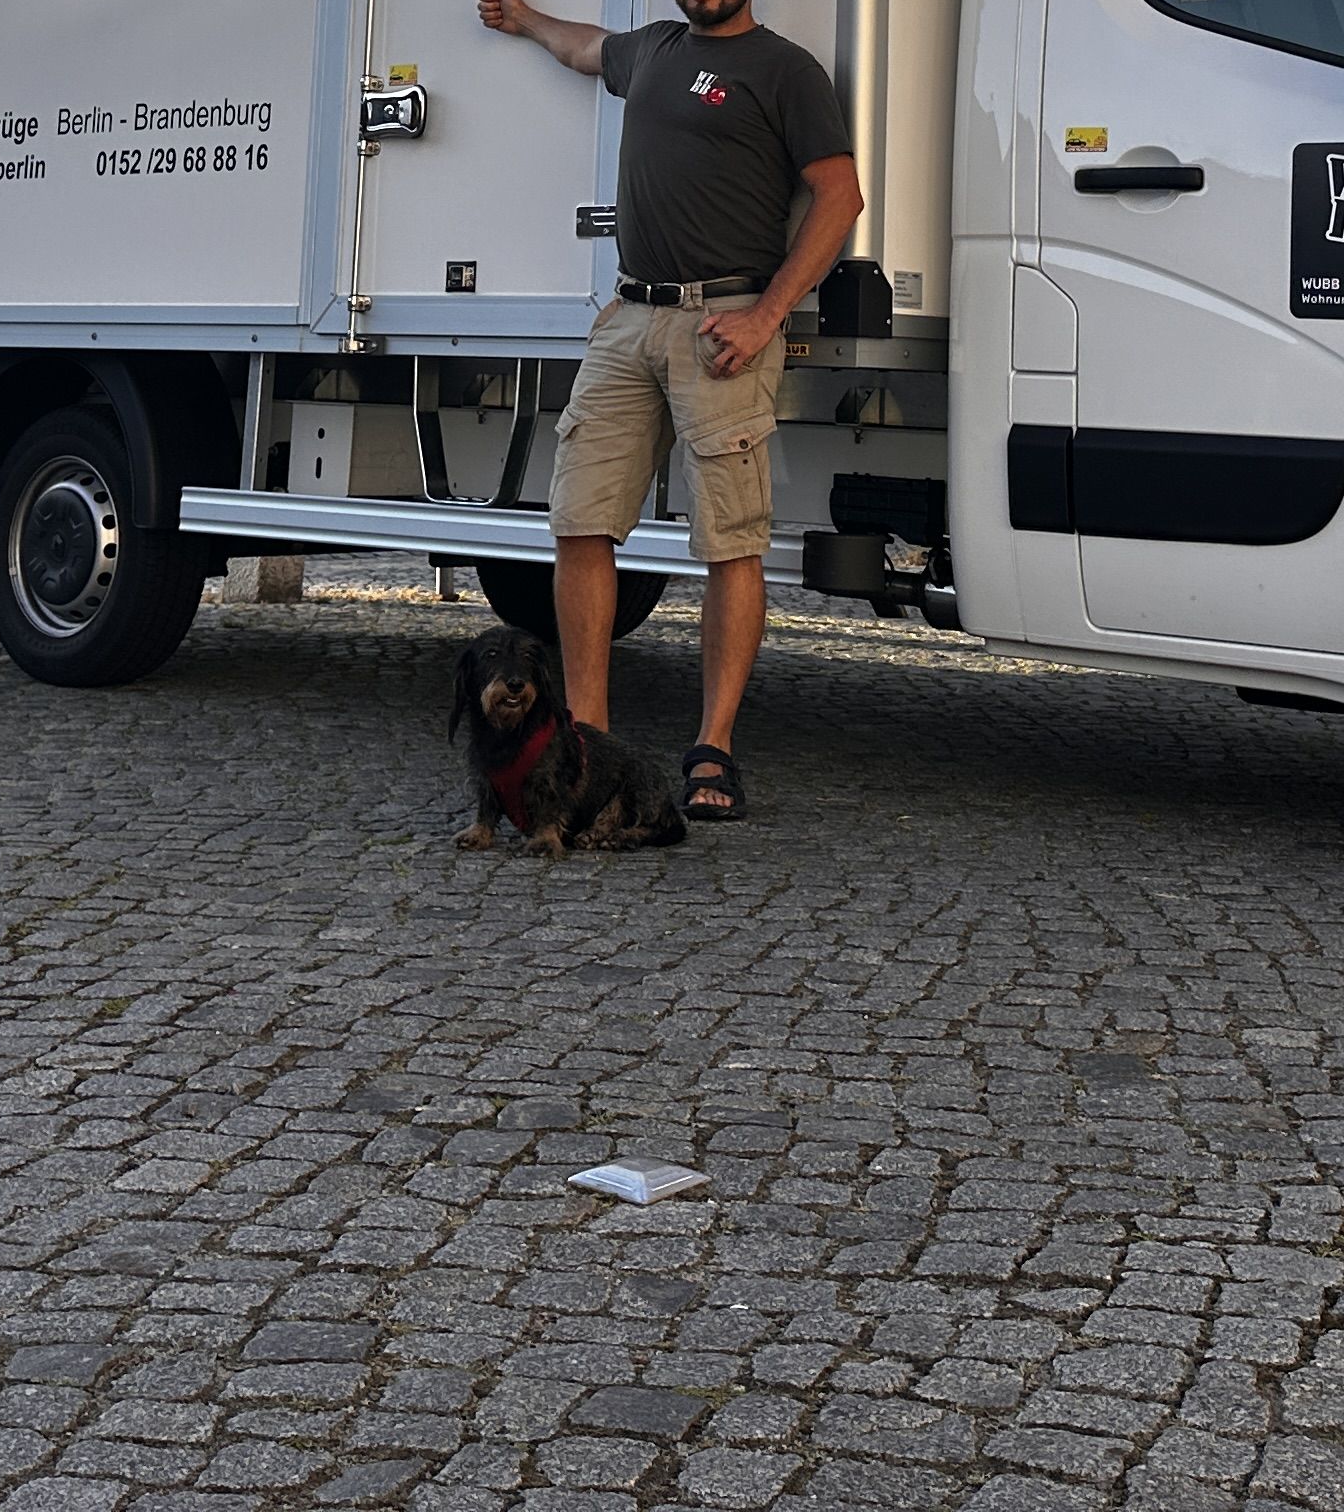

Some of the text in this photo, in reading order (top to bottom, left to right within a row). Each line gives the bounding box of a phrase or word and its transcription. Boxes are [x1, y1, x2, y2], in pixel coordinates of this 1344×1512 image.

[57, 106, 113, 136] Berlin
[134, 97, 272, 133] Brandenburg
[96, 148, 142, 176] 0152
[183, 146, 207, 173] 68
[212, 145, 237, 172] 88
[244, 143, 269, 171] 16
[1301, 277, 1341, 290] WUBB
